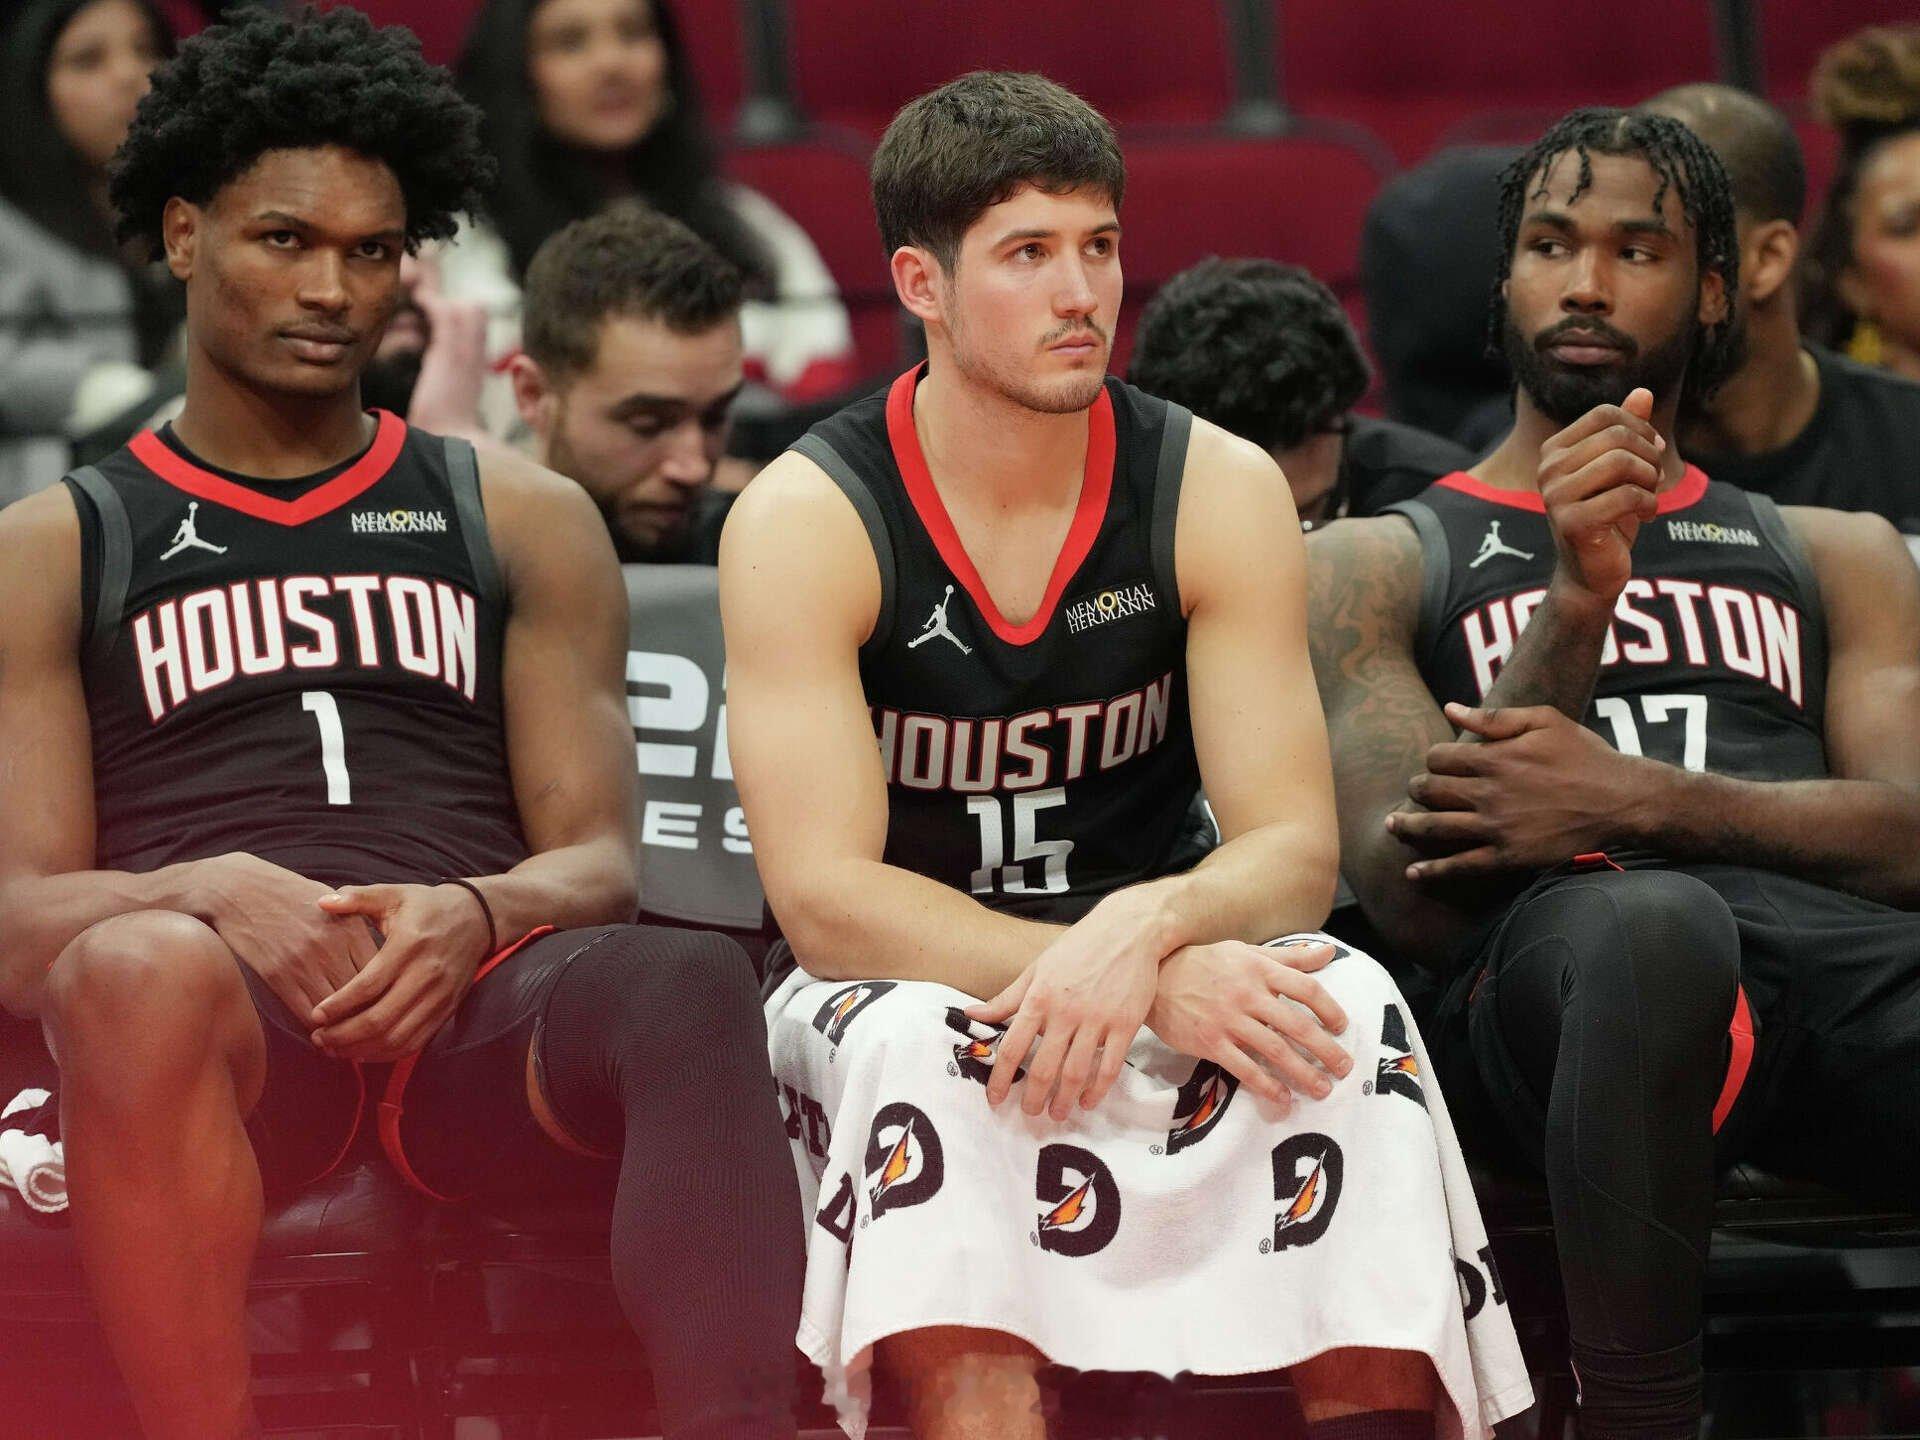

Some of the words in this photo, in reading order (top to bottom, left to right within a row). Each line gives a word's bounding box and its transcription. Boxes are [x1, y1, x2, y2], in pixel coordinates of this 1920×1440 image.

[351, 510, 446, 524] MEMORIAL
[352, 519, 447, 533] HERMANN
[1065, 584, 1154, 620] MEMORIAL
[1068, 596, 1156, 634] HERMANN
[133, 573, 477, 725] HOUSTON
[1462, 577, 1803, 708] HSTON
[302, 691, 351, 805] 1
[1595, 694, 1709, 773] 17
[967, 787, 1075, 894] 15
